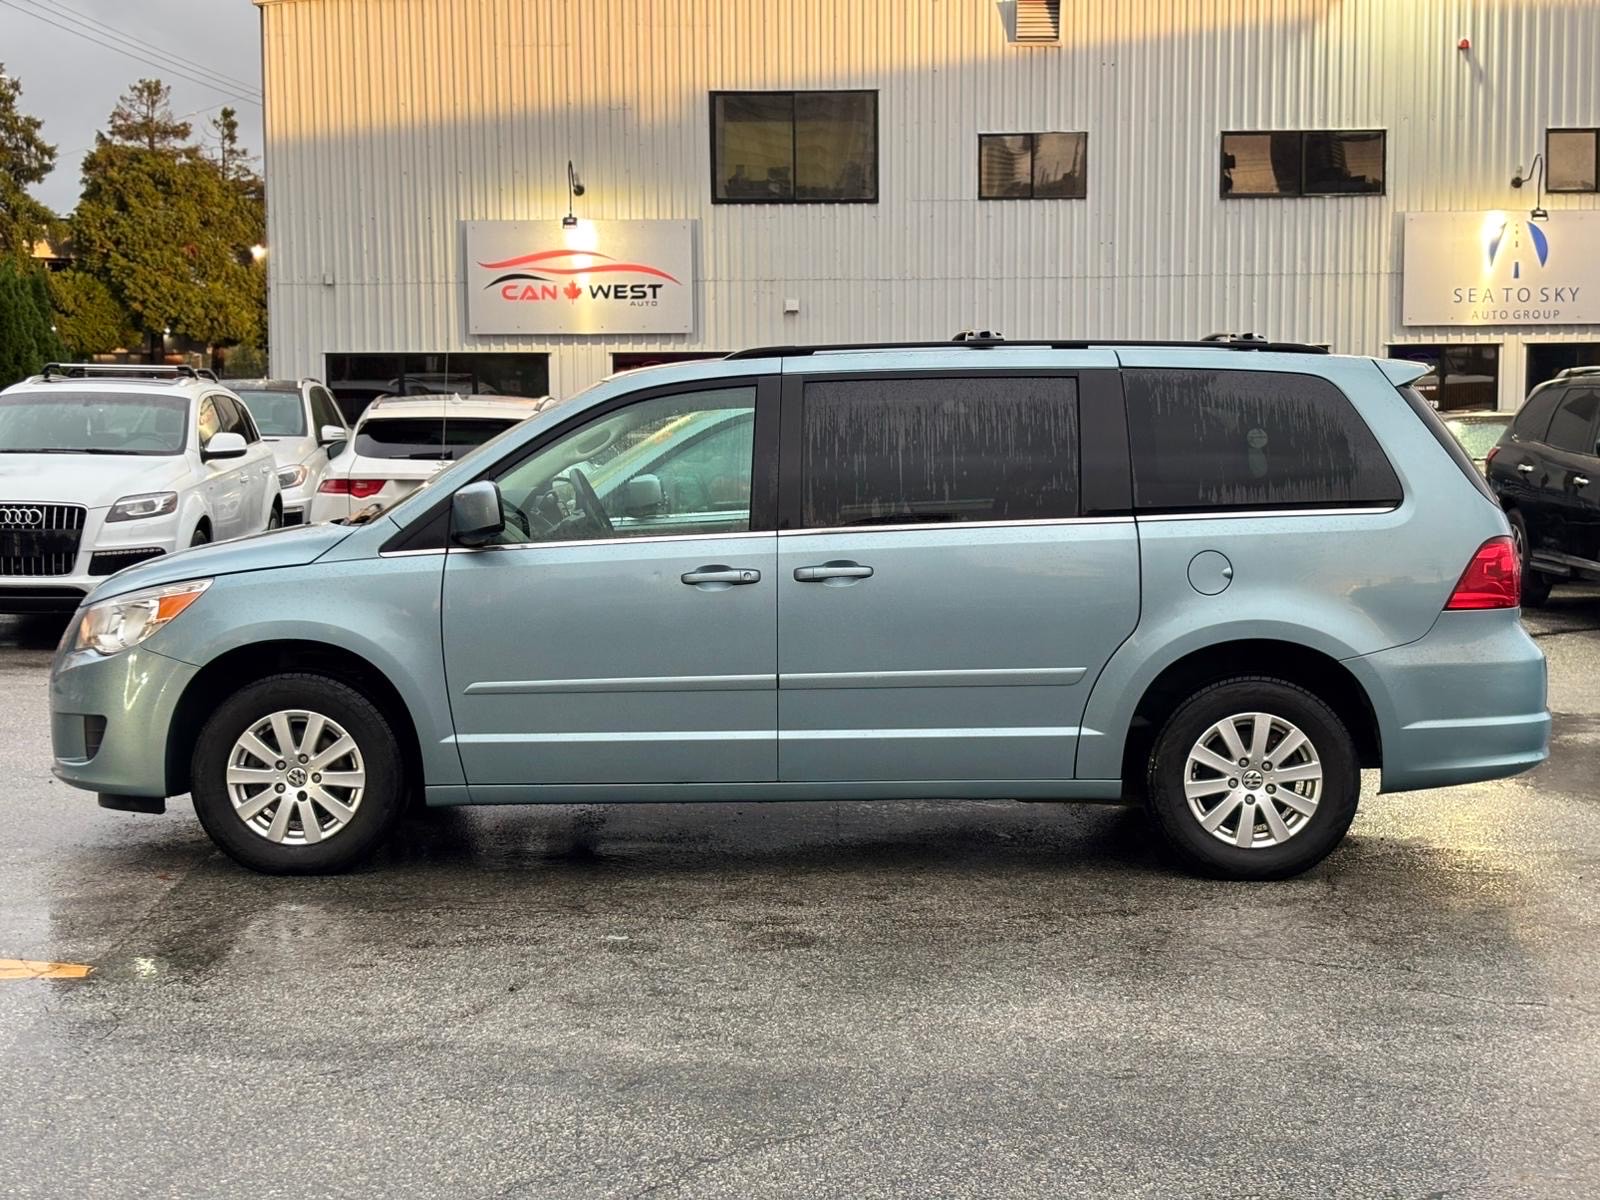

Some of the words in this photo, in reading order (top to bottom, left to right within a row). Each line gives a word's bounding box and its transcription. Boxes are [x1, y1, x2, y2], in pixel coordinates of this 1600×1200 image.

[502, 285, 557, 301] CAN
[589, 284, 664, 300] WEST
[1453, 287, 1494, 303] SEA
[1503, 287, 1531, 302] TO
[1540, 287, 1580, 302] SKY
[1472, 311, 1509, 320] AUTO
[1513, 310, 1560, 319] GROUP
